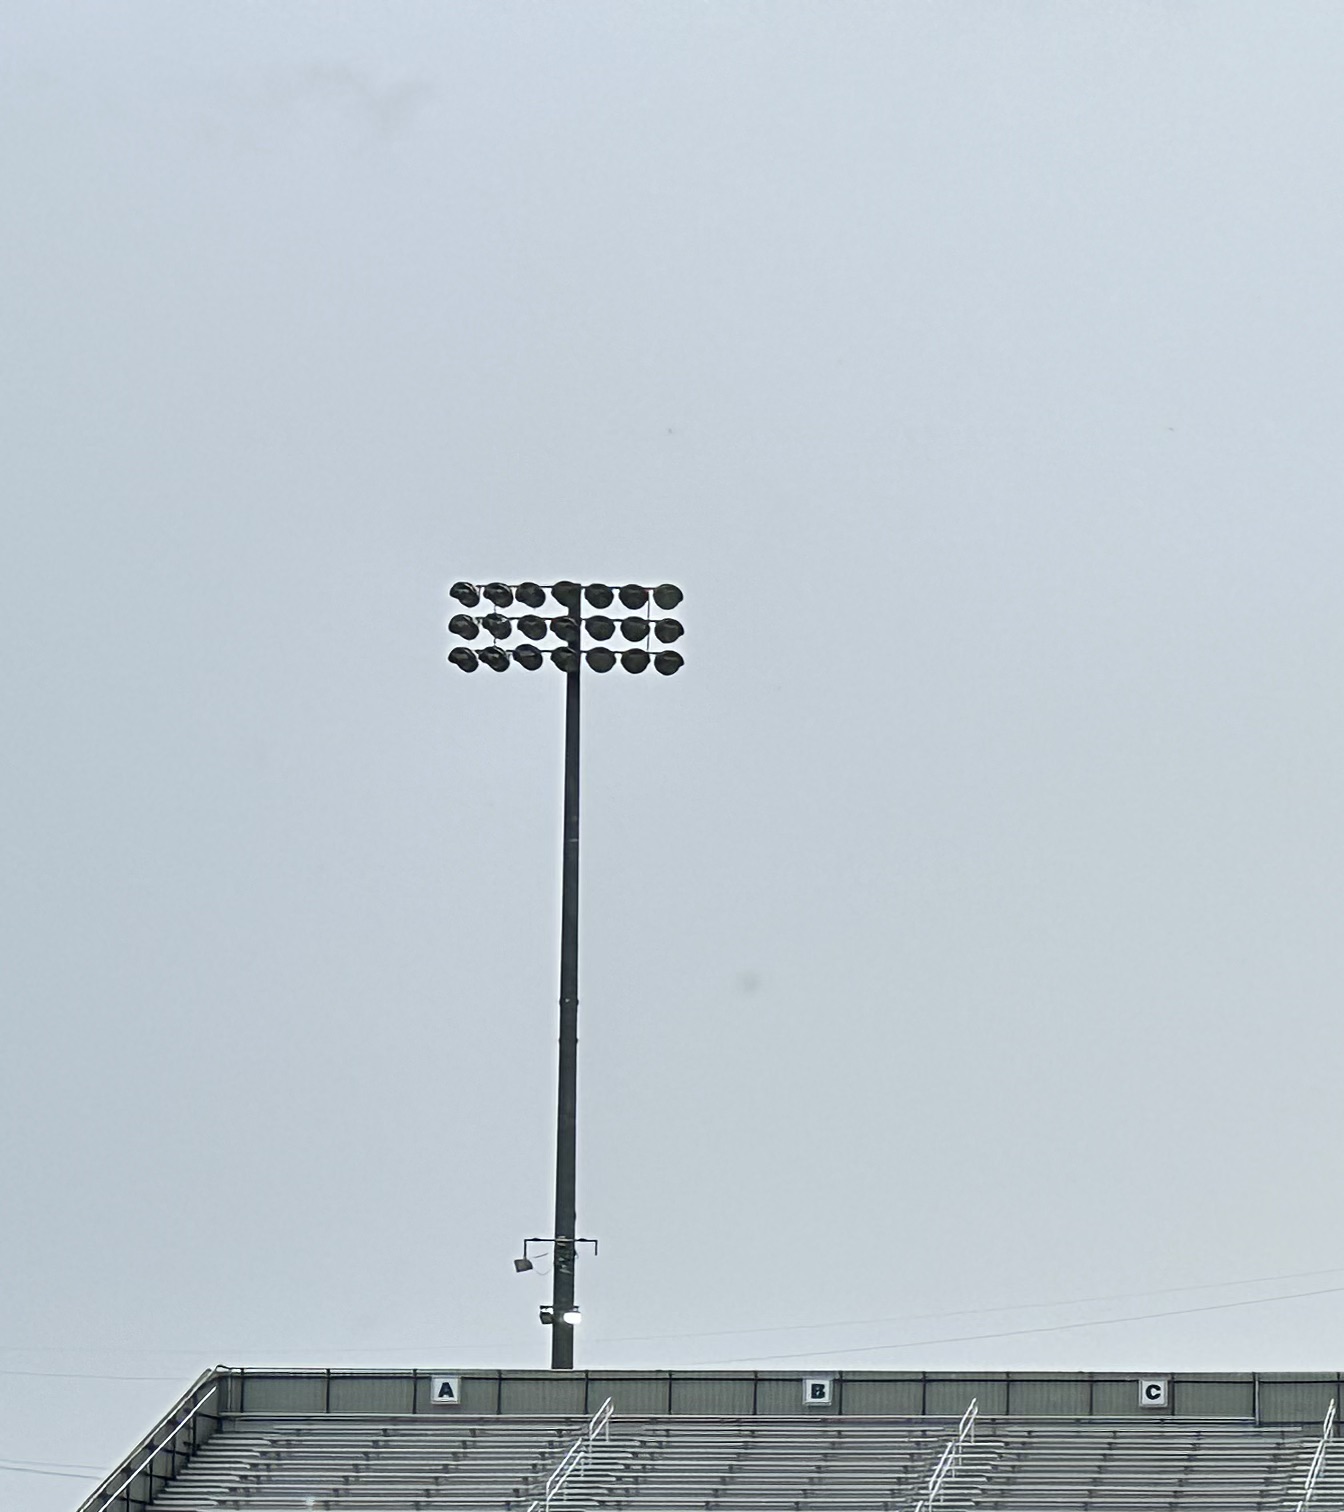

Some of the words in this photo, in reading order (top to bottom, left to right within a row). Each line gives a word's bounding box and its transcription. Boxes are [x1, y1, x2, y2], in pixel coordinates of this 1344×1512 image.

[438, 1382, 454, 1398] A
[811, 1384, 826, 1399] B
[1146, 1384, 1161, 1400] C
